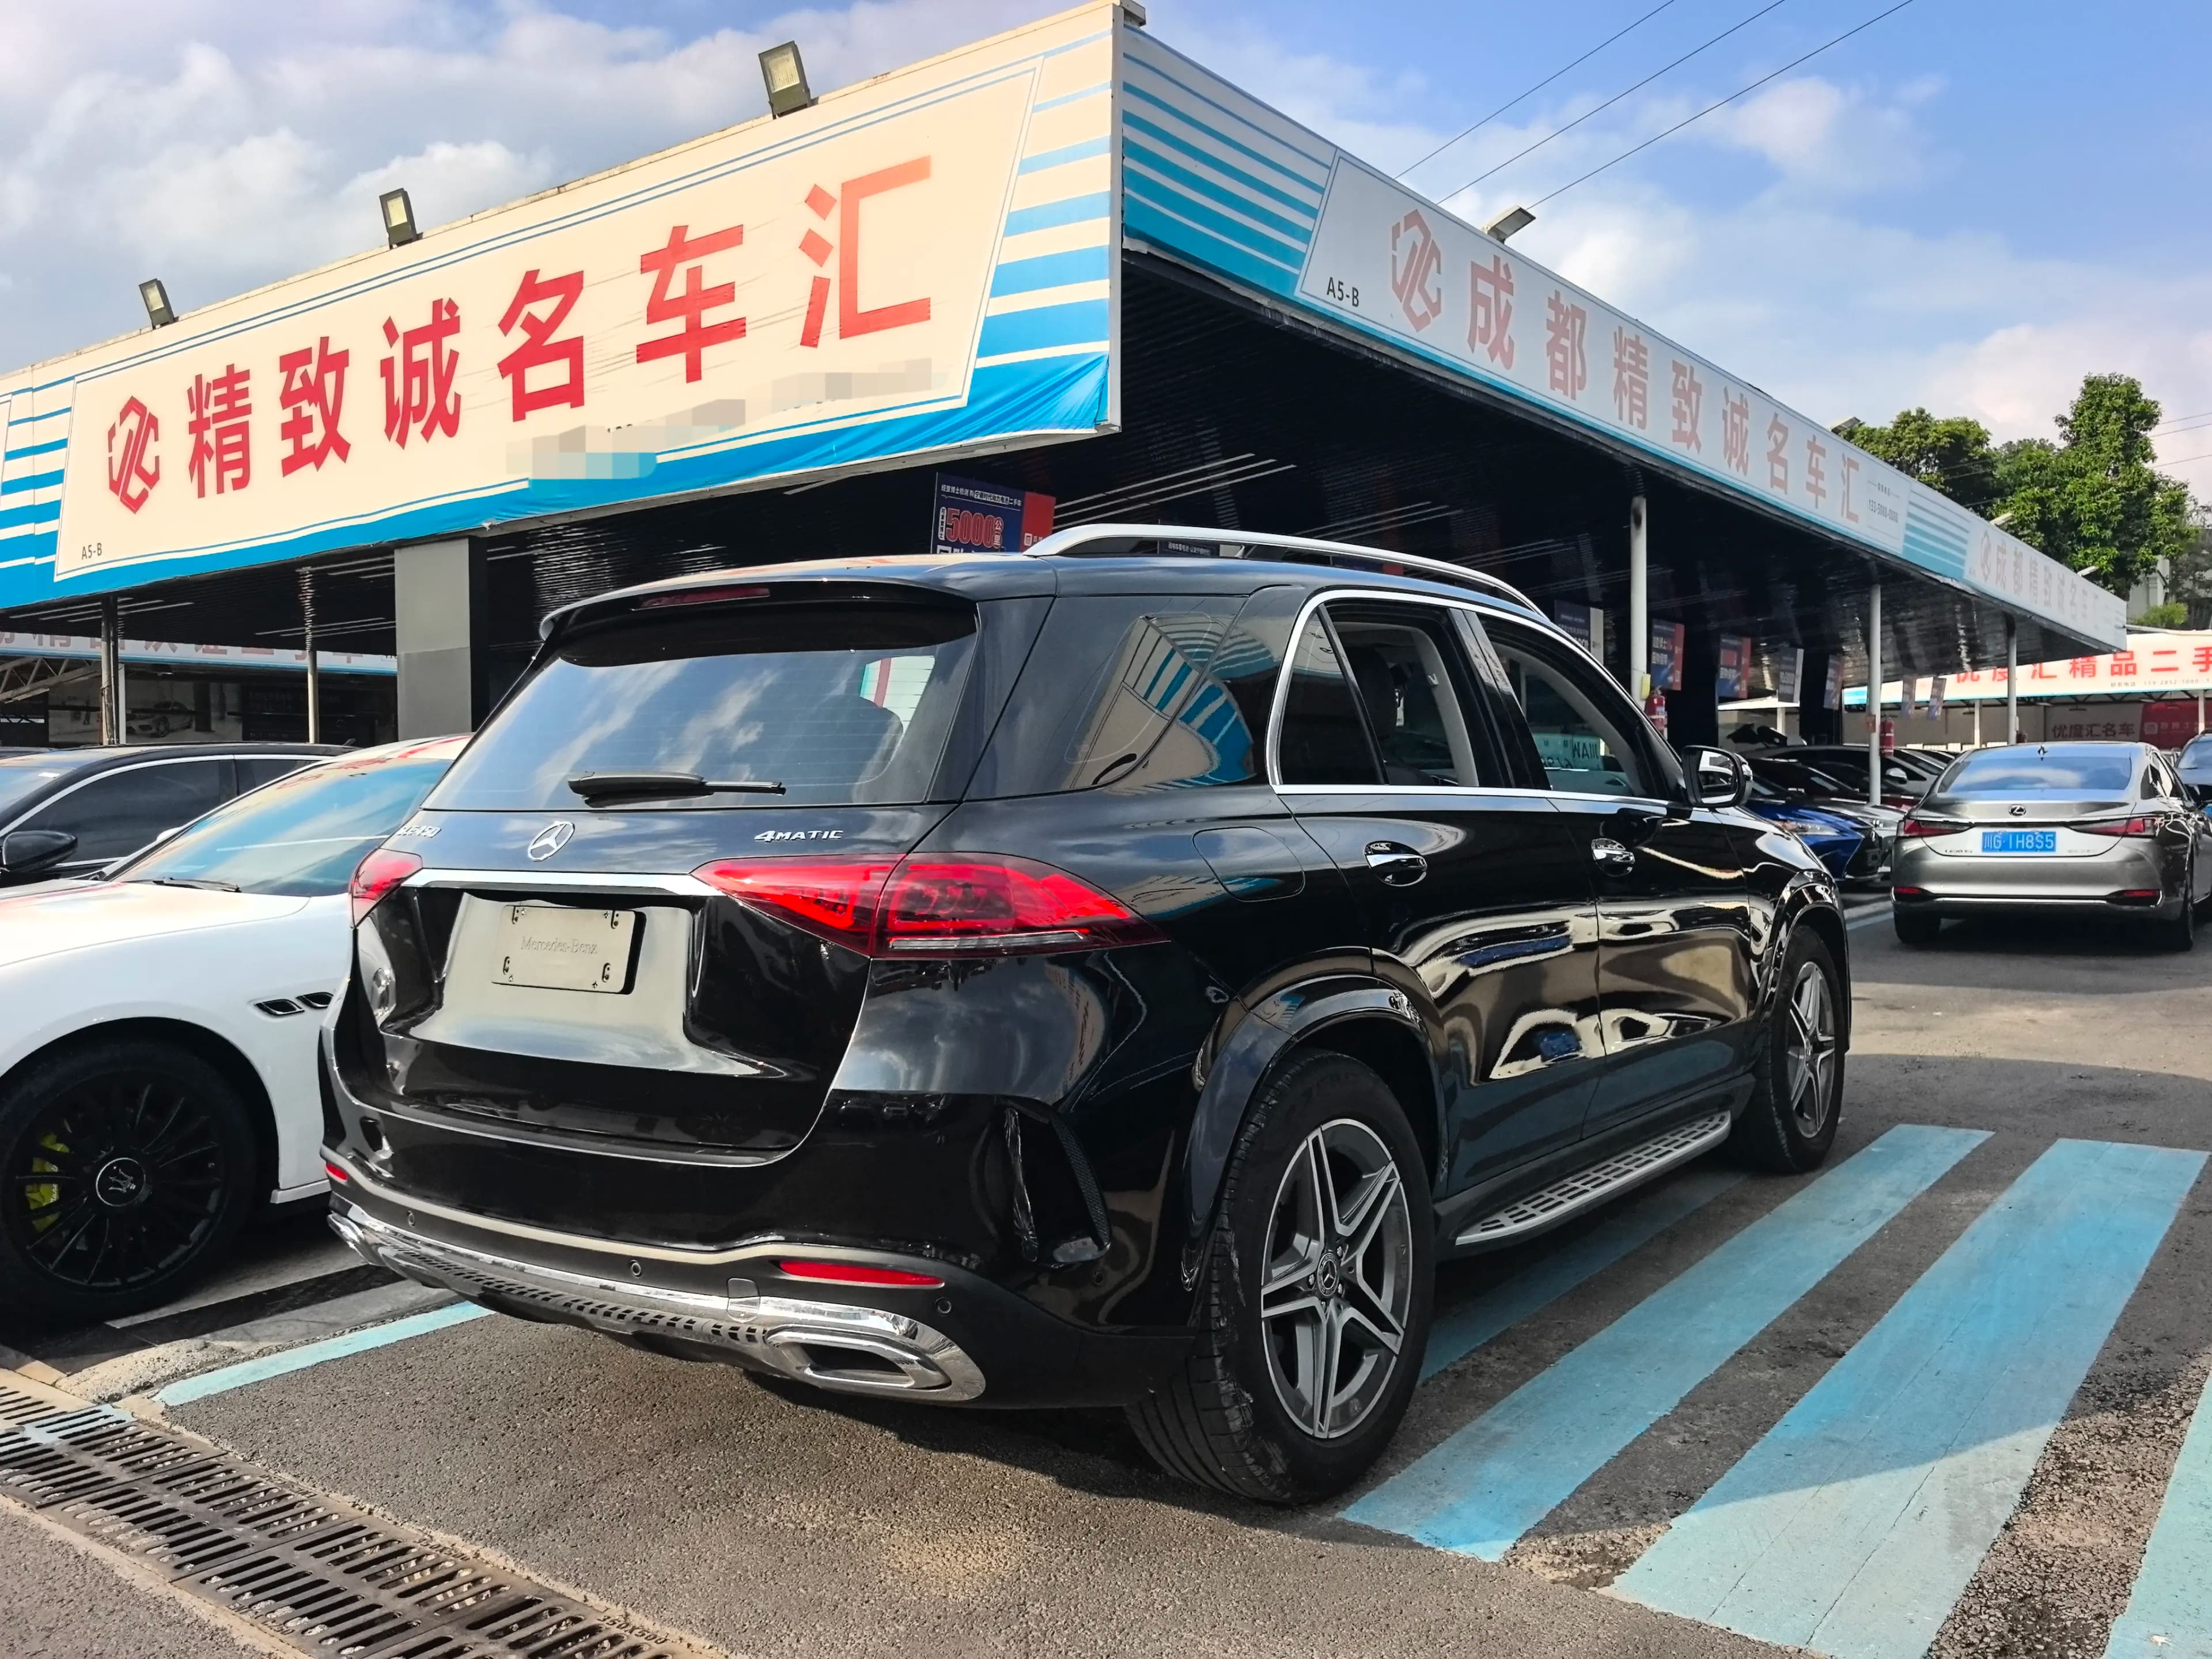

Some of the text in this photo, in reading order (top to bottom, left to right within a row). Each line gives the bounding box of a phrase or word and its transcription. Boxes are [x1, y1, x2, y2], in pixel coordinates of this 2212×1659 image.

[1326, 276, 1360, 308] A5-B
[186, 156, 932, 499] 精致诚名车汇
[1467, 255, 1860, 524] 成都精致诚名车汇
[946, 507, 996, 548] 5000
[994, 517, 1004, 547] 公里
[81, 542, 103, 560] A5-B
[2051, 722, 2136, 738] 优度汇名车
[753, 830, 844, 843] 4MATIC
[521, 935, 599, 955] Mercedes-Benz
